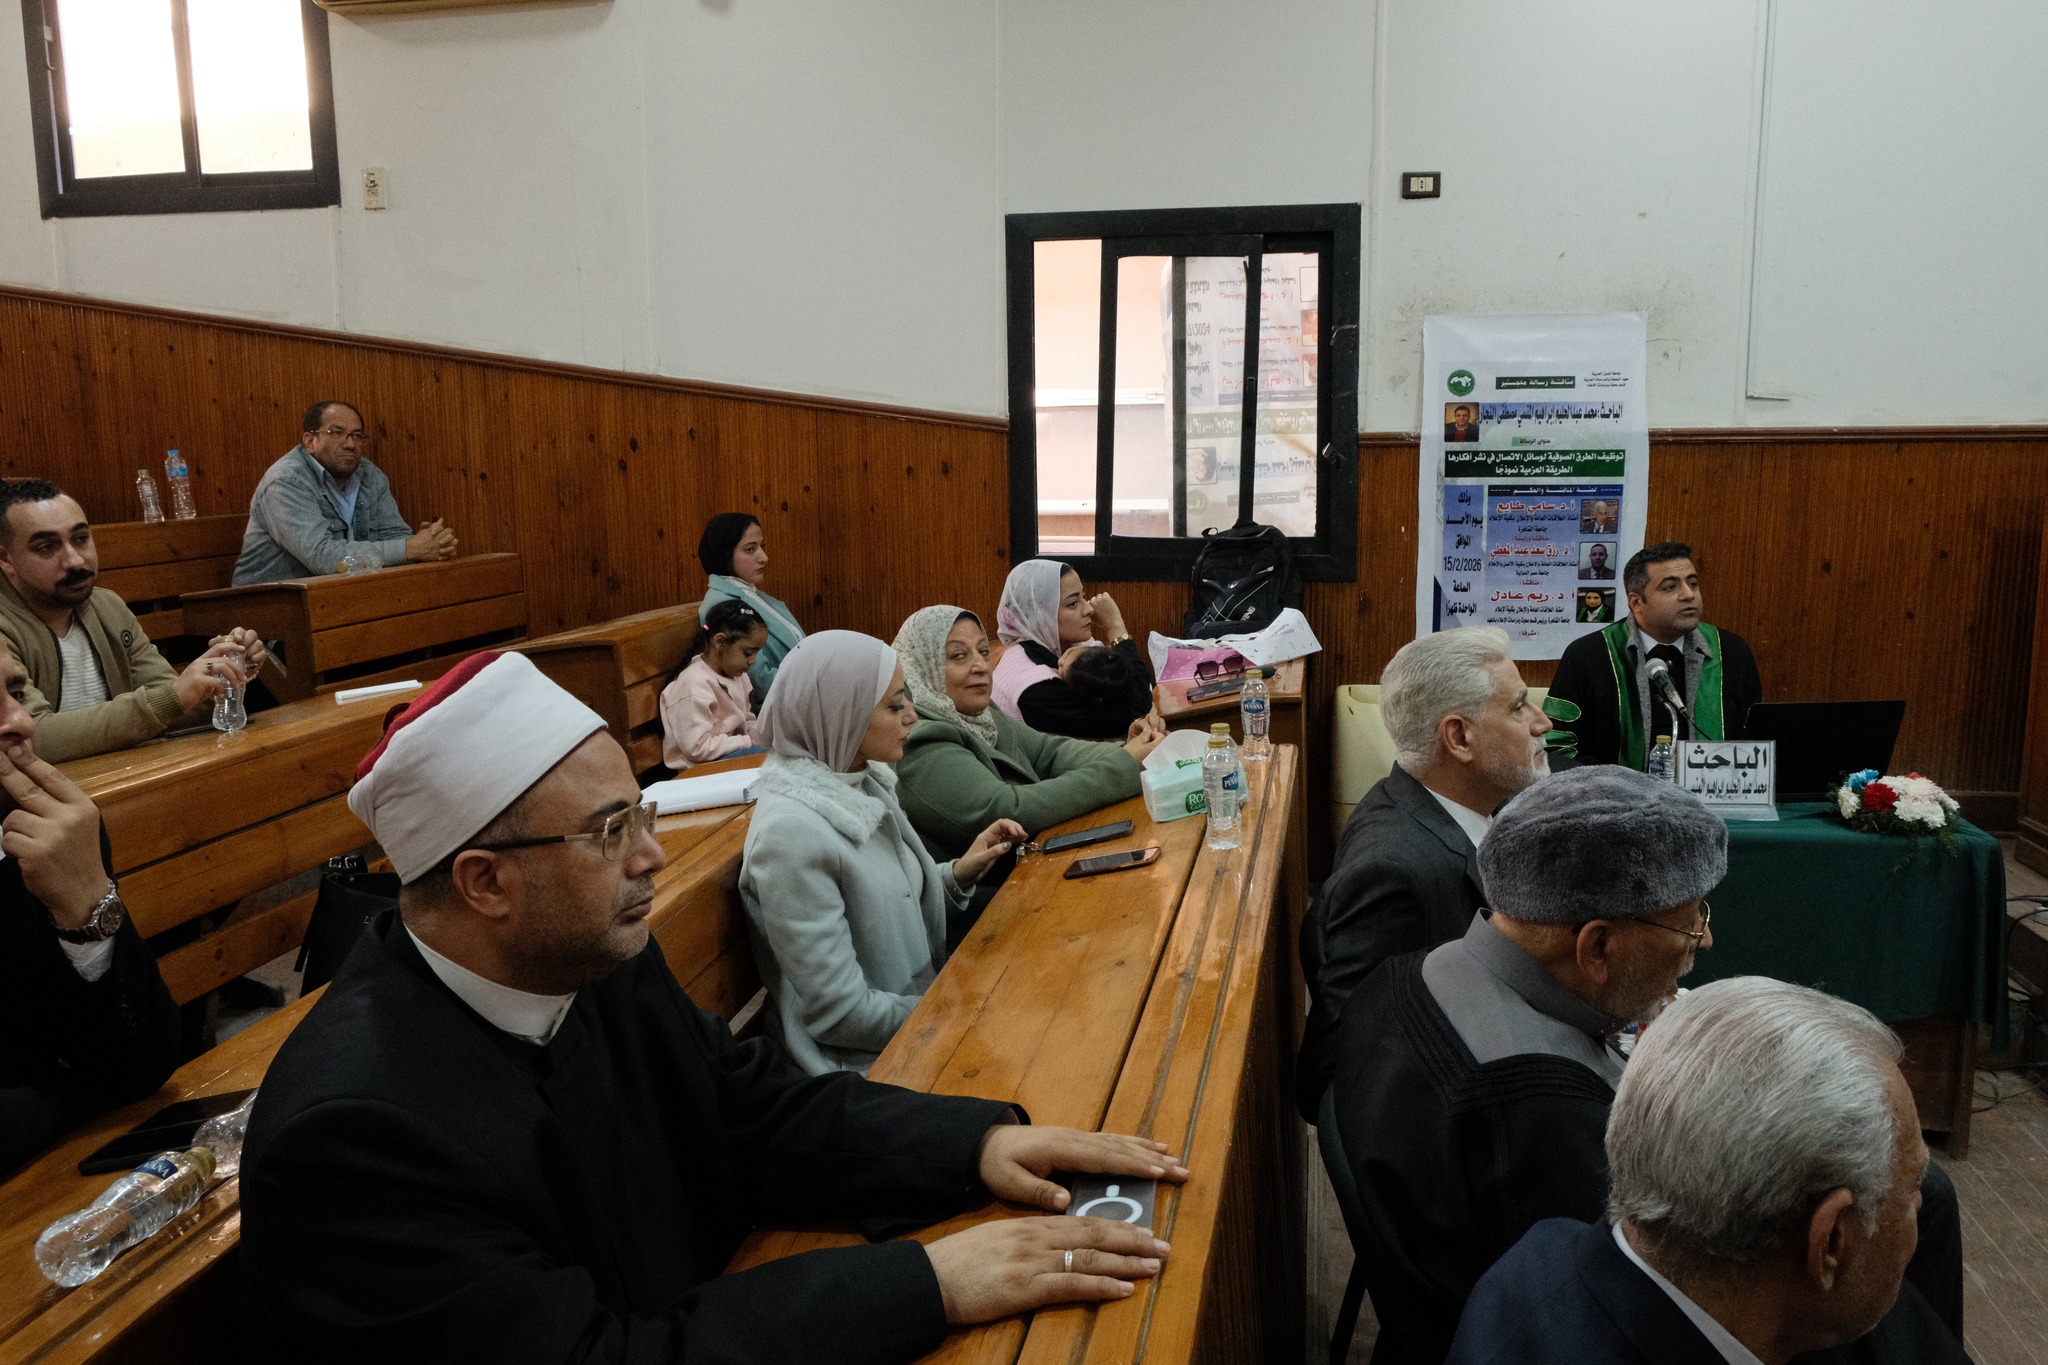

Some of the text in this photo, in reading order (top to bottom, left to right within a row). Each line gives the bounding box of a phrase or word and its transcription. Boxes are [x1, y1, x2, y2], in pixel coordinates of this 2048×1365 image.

[1530, 378, 1549, 387] رسالة
[1551, 378, 1573, 386] مناقشة
[1479, 405, 1496, 424] النجار
[1584, 405, 1597, 420] محمد
[1448, 452, 1624, 464] توظيف الطرق الصوفية لوسائل الاتصال في نشر أفكارها
[1520, 465, 1544, 476] العزمية
[1546, 465, 1573, 476] الطريقة
[1458, 490, 1471, 505] وذلك
[1497, 501, 1525, 514] طايع
[1528, 501, 1555, 515] سامي
[1472, 515, 1483, 528] يوم
[1456, 534, 1471, 549] الموافق
[1491, 544, 1513, 560] المعطي
[1514, 544, 1529, 558] عبد
[1530, 545, 1545, 556] سعد
[1546, 544, 1559, 558] رزق
[1444, 556, 1482, 571] 15/2/2026
[1453, 580, 1470, 592] الساعة
[1490, 590, 1524, 602] عادل
[1527, 592, 1549, 603] ريم
[1458, 602, 1477, 616] الواحدة
[1687, 744, 1768, 778] الباحث
